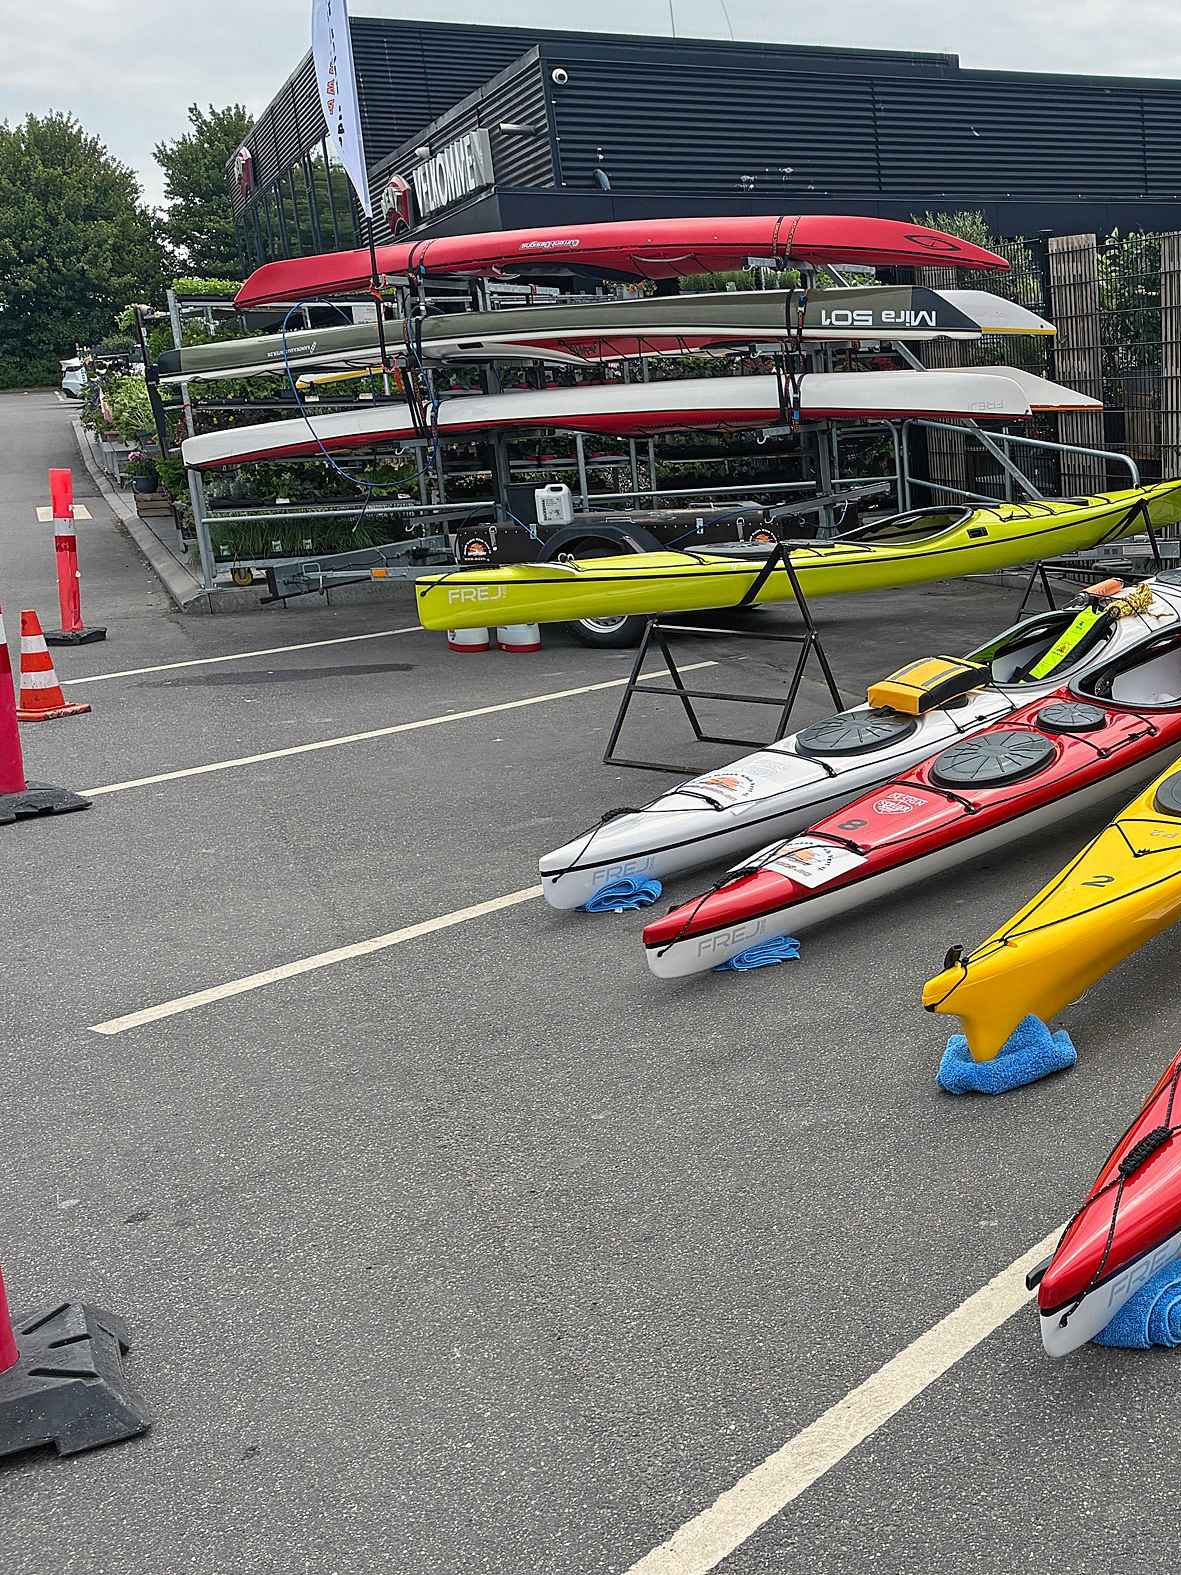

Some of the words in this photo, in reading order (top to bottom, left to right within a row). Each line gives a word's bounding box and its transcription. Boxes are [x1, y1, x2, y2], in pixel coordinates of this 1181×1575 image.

[412, 128, 495, 218] VELKOMMEN
[821, 309, 873, 326] 501
[881, 310, 936, 327] Mira
[970, 400, 1004, 411] FREJ
[448, 584, 502, 605] FREJ
[837, 819, 868, 831] 8
[592, 857, 650, 886] FREJ
[1080, 875, 1115, 888] 2
[697, 920, 761, 958] FREJ
